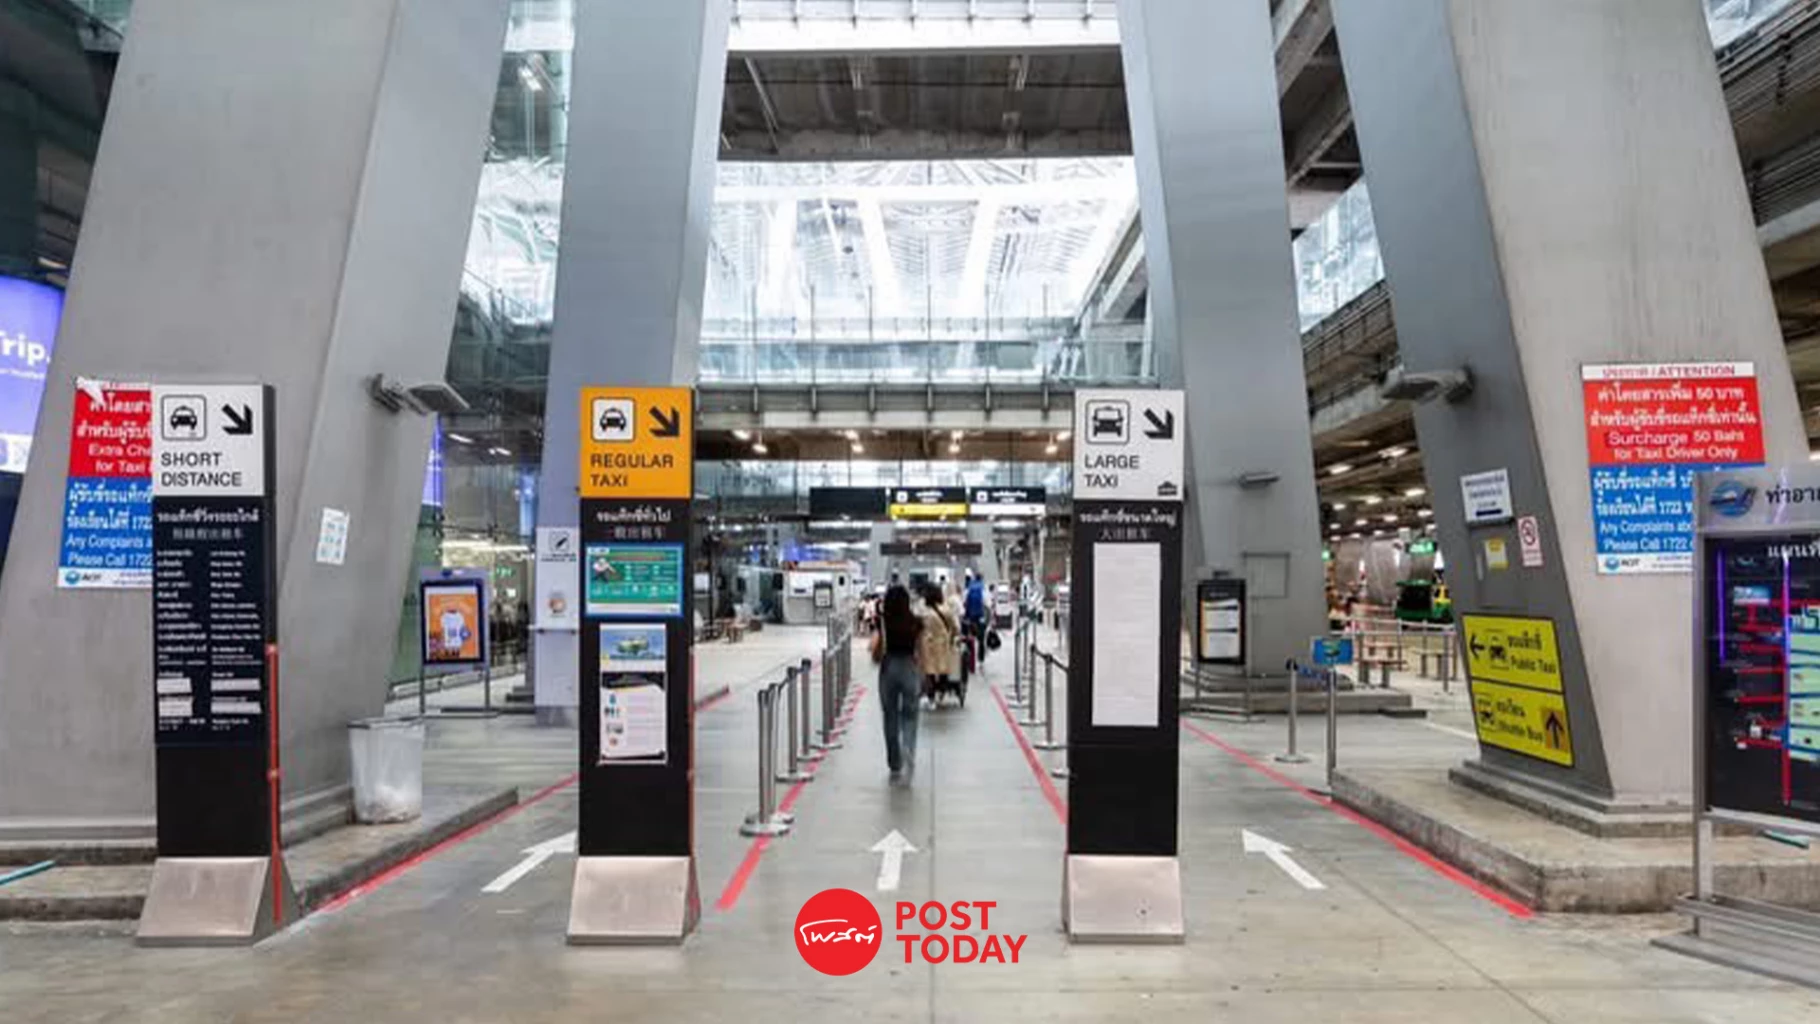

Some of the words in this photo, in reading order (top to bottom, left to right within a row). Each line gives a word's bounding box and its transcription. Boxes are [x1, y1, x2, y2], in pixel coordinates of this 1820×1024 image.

[1659, 366, 1735, 378] ATTENTION
[1696, 386, 1713, 400] 50
[1608, 432, 1688, 448] Surcharge
[1693, 431, 1711, 442] 50
[1714, 429, 1745, 441] Baht
[88, 443, 124, 456] Extra
[1614, 448, 1631, 460] for
[1635, 447, 1662, 459] Taxi
[1666, 446, 1704, 459] Driver
[1707, 445, 1738, 460] Only
[95, 459, 114, 472] for
[118, 459, 146, 473] Taxi
[161, 453, 222, 467] SHORT
[590, 453, 674, 468] REGULAR
[1084, 455, 1140, 469] LARGE
[161, 472, 242, 487] DISTANCE
[590, 474, 628, 487] TAXI
[1084, 474, 1118, 487] TAXI
[1765, 484, 1820, 503] ท่าอา
[1659, 501, 1683, 515] 1722
[1600, 521, 1618, 536] Any
[1620, 520, 1675, 534] Complaints
[65, 533, 86, 551] Any
[88, 533, 144, 551] Complaints
[1603, 537, 1639, 550] Please
[1640, 537, 1661, 550] Call
[1663, 536, 1688, 550] 1722
[67, 551, 104, 567] Please
[105, 552, 127, 567] Call
